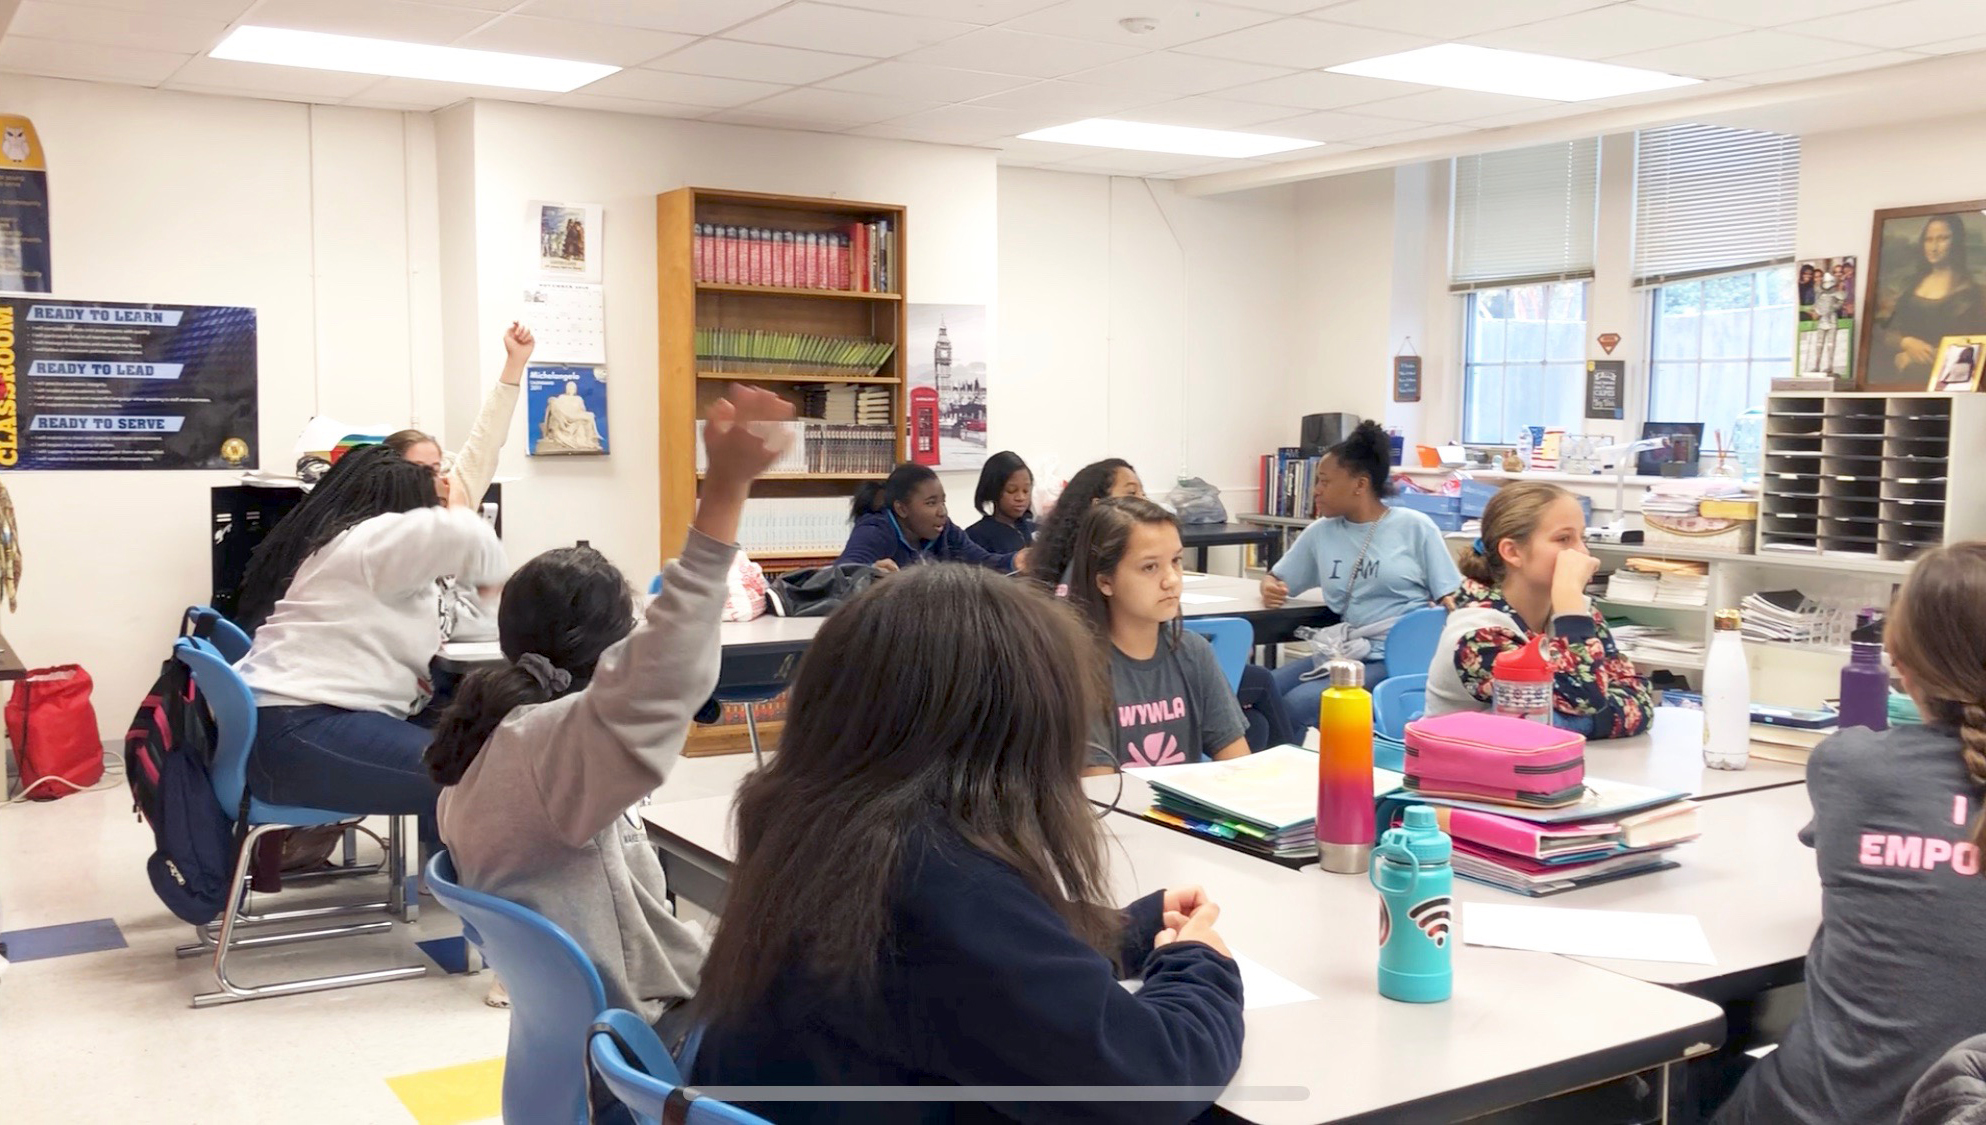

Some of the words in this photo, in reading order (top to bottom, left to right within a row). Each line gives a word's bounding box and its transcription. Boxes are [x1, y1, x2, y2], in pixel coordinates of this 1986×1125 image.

[34, 307, 84, 320] READY
[90, 309, 110, 321] TO
[115, 310, 163, 323] LEARN
[36, 362, 87, 374] READY
[91, 363, 112, 375] TO
[116, 364, 154, 376] LEAD
[38, 417, 88, 429] READY
[93, 418, 113, 429] TO
[118, 418, 165, 429] SERVE
[1328, 560, 1342, 579] I
[1353, 558, 1380, 580] AM
[1118, 696, 1186, 727] WYWLA
[1953, 794, 1968, 825] I
[1859, 833, 1980, 876] EMPO
